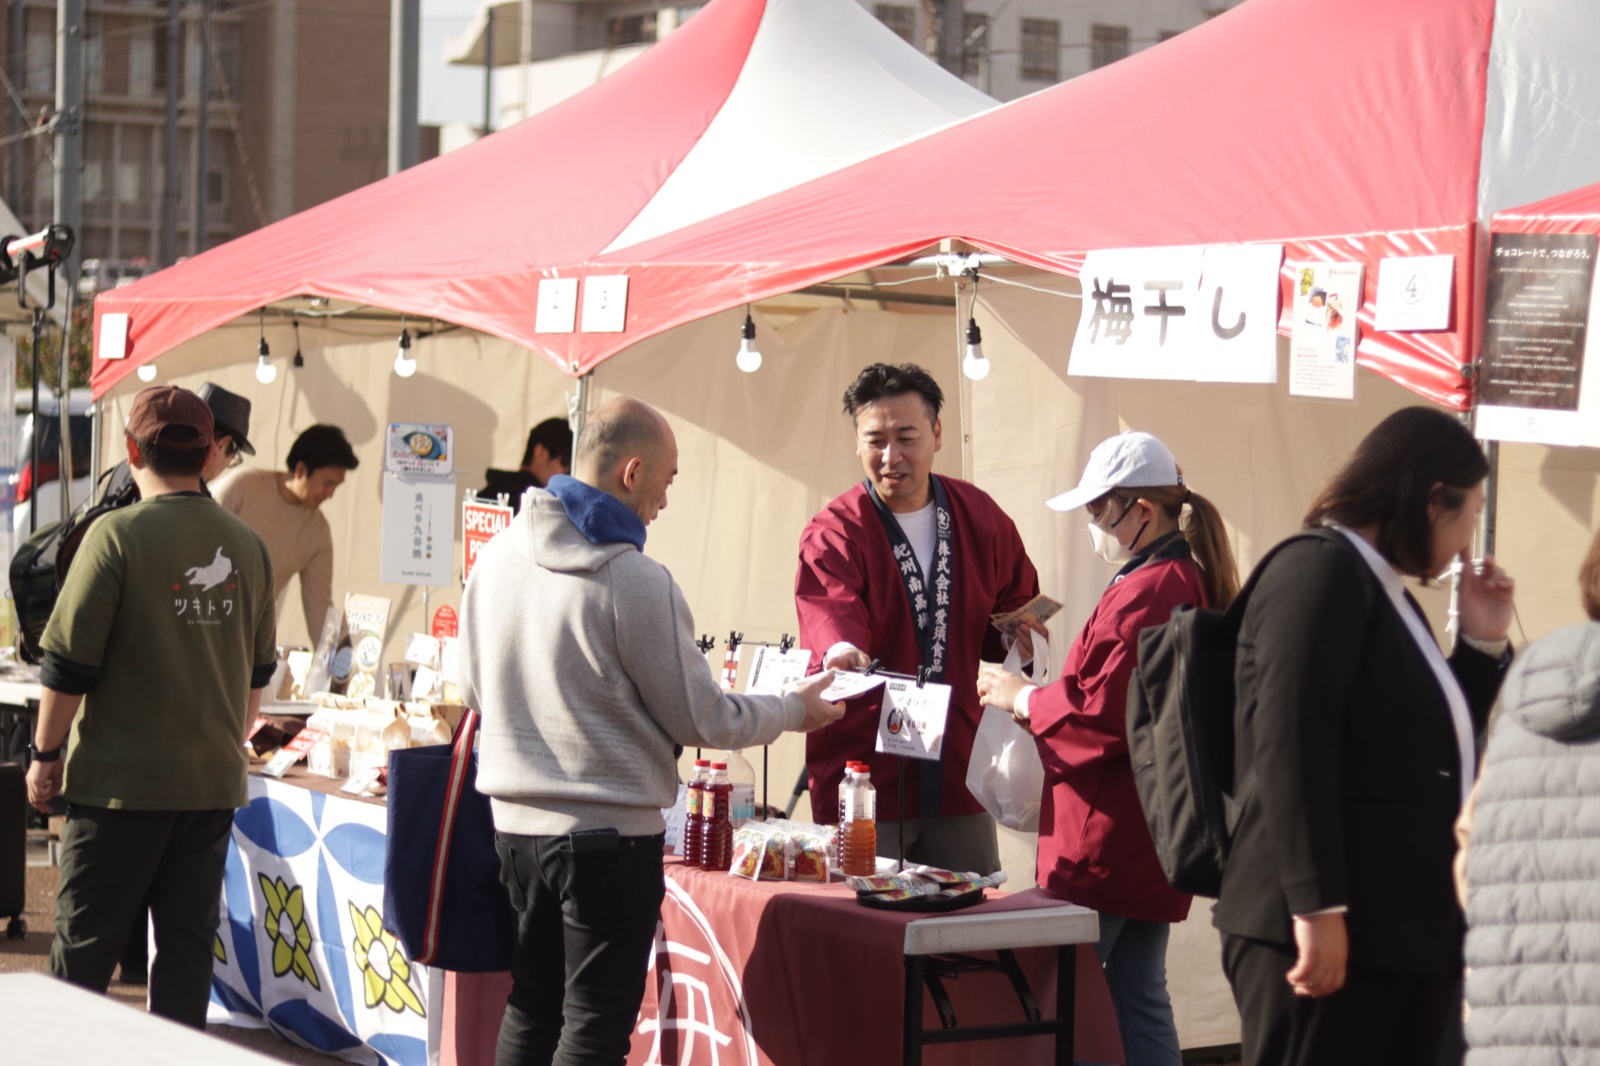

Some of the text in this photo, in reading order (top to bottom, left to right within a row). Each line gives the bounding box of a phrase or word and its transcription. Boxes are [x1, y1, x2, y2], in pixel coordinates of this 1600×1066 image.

[1495, 247, 1590, 259] チョコレートで、つながろう。
[1088, 276, 1246, 346] 梅干し
[465, 508, 507, 534] SPECIAL
[174, 597, 234, 616] ツキトワ
